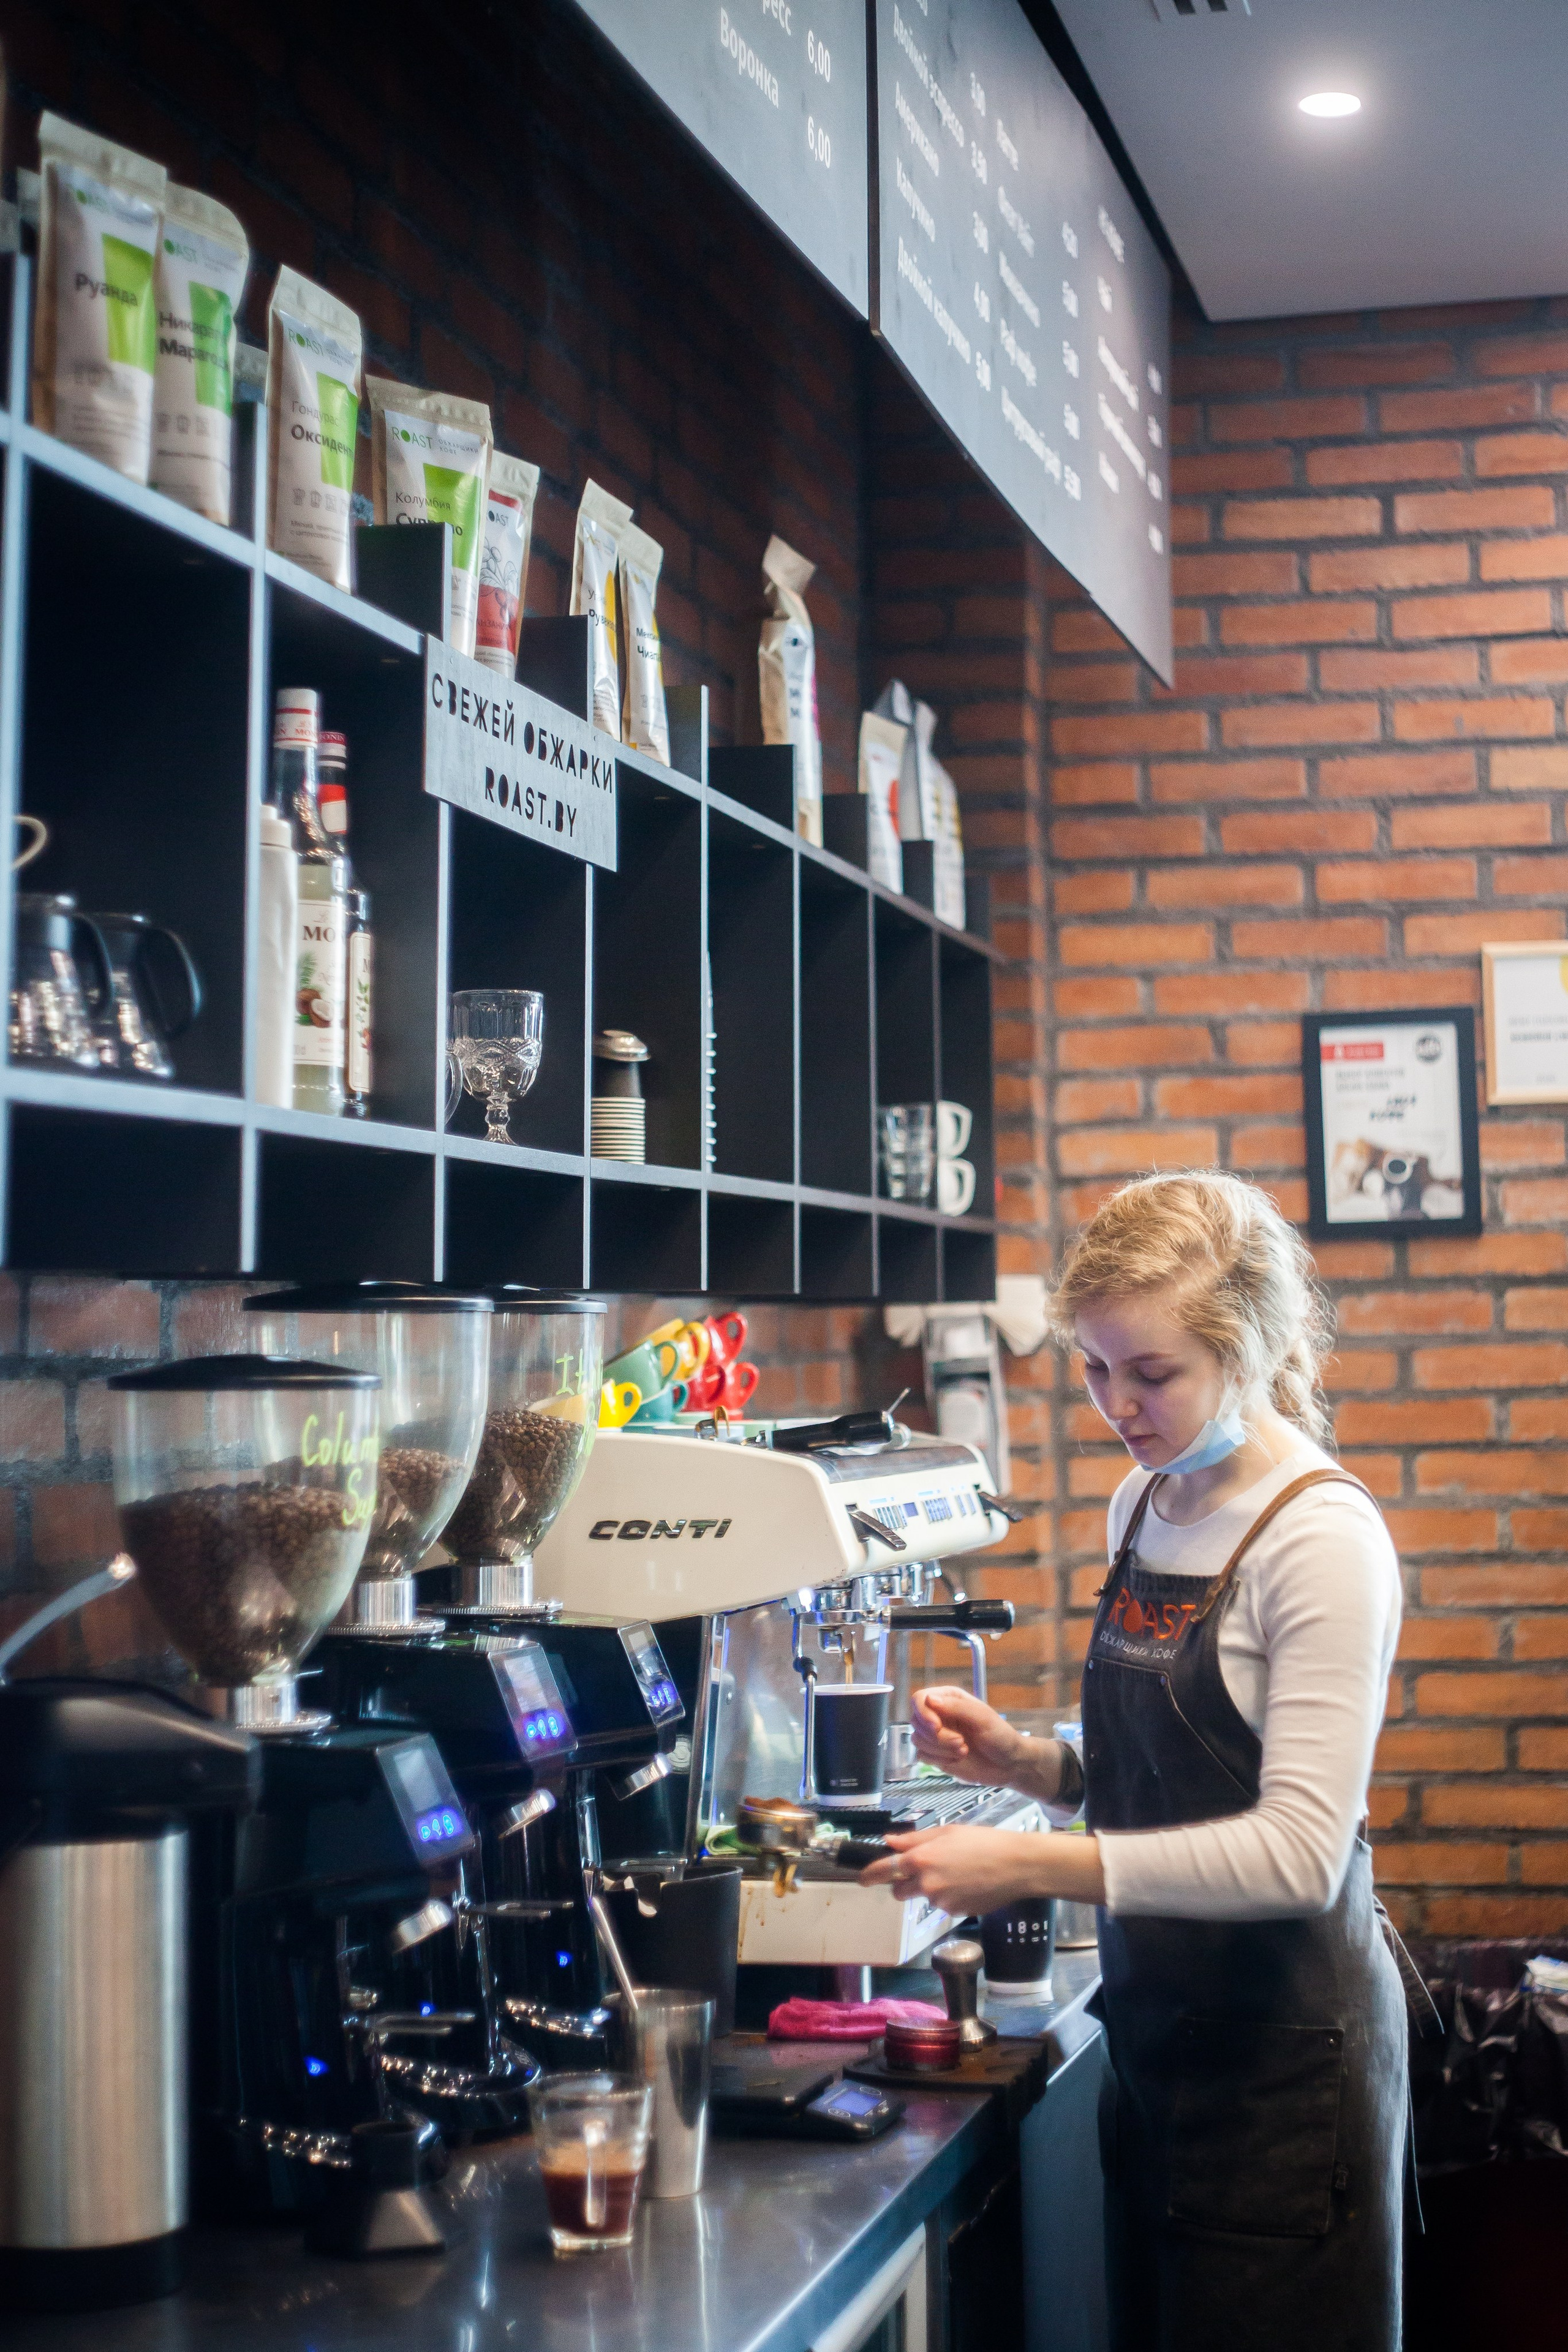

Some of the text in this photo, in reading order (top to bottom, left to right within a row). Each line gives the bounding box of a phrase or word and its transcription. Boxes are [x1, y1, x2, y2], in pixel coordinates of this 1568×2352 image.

[808, 31, 831, 83] 6,00
[721, 7, 831, 168] Воронка 6,00
[895, 81, 940, 176] Американо
[896, 157, 936, 243] Капучино
[74, 272, 138, 307] Руанда
[291, 401, 339, 428] Гондурас
[391, 427, 433, 450] ROAST
[395, 492, 451, 511] Колумбия
[432, 673, 516, 746] СВЕЖЕЙ
[523, 721, 612, 794] ОБЖАРКИ
[484, 766, 578, 837] ROAST.BY
[588, 1518, 733, 1541] CONTI
[1107, 1585, 1197, 1642] ROAST
[1099, 1630, 1177, 1660] ОБЖАРЩИКИ КОФЕ
